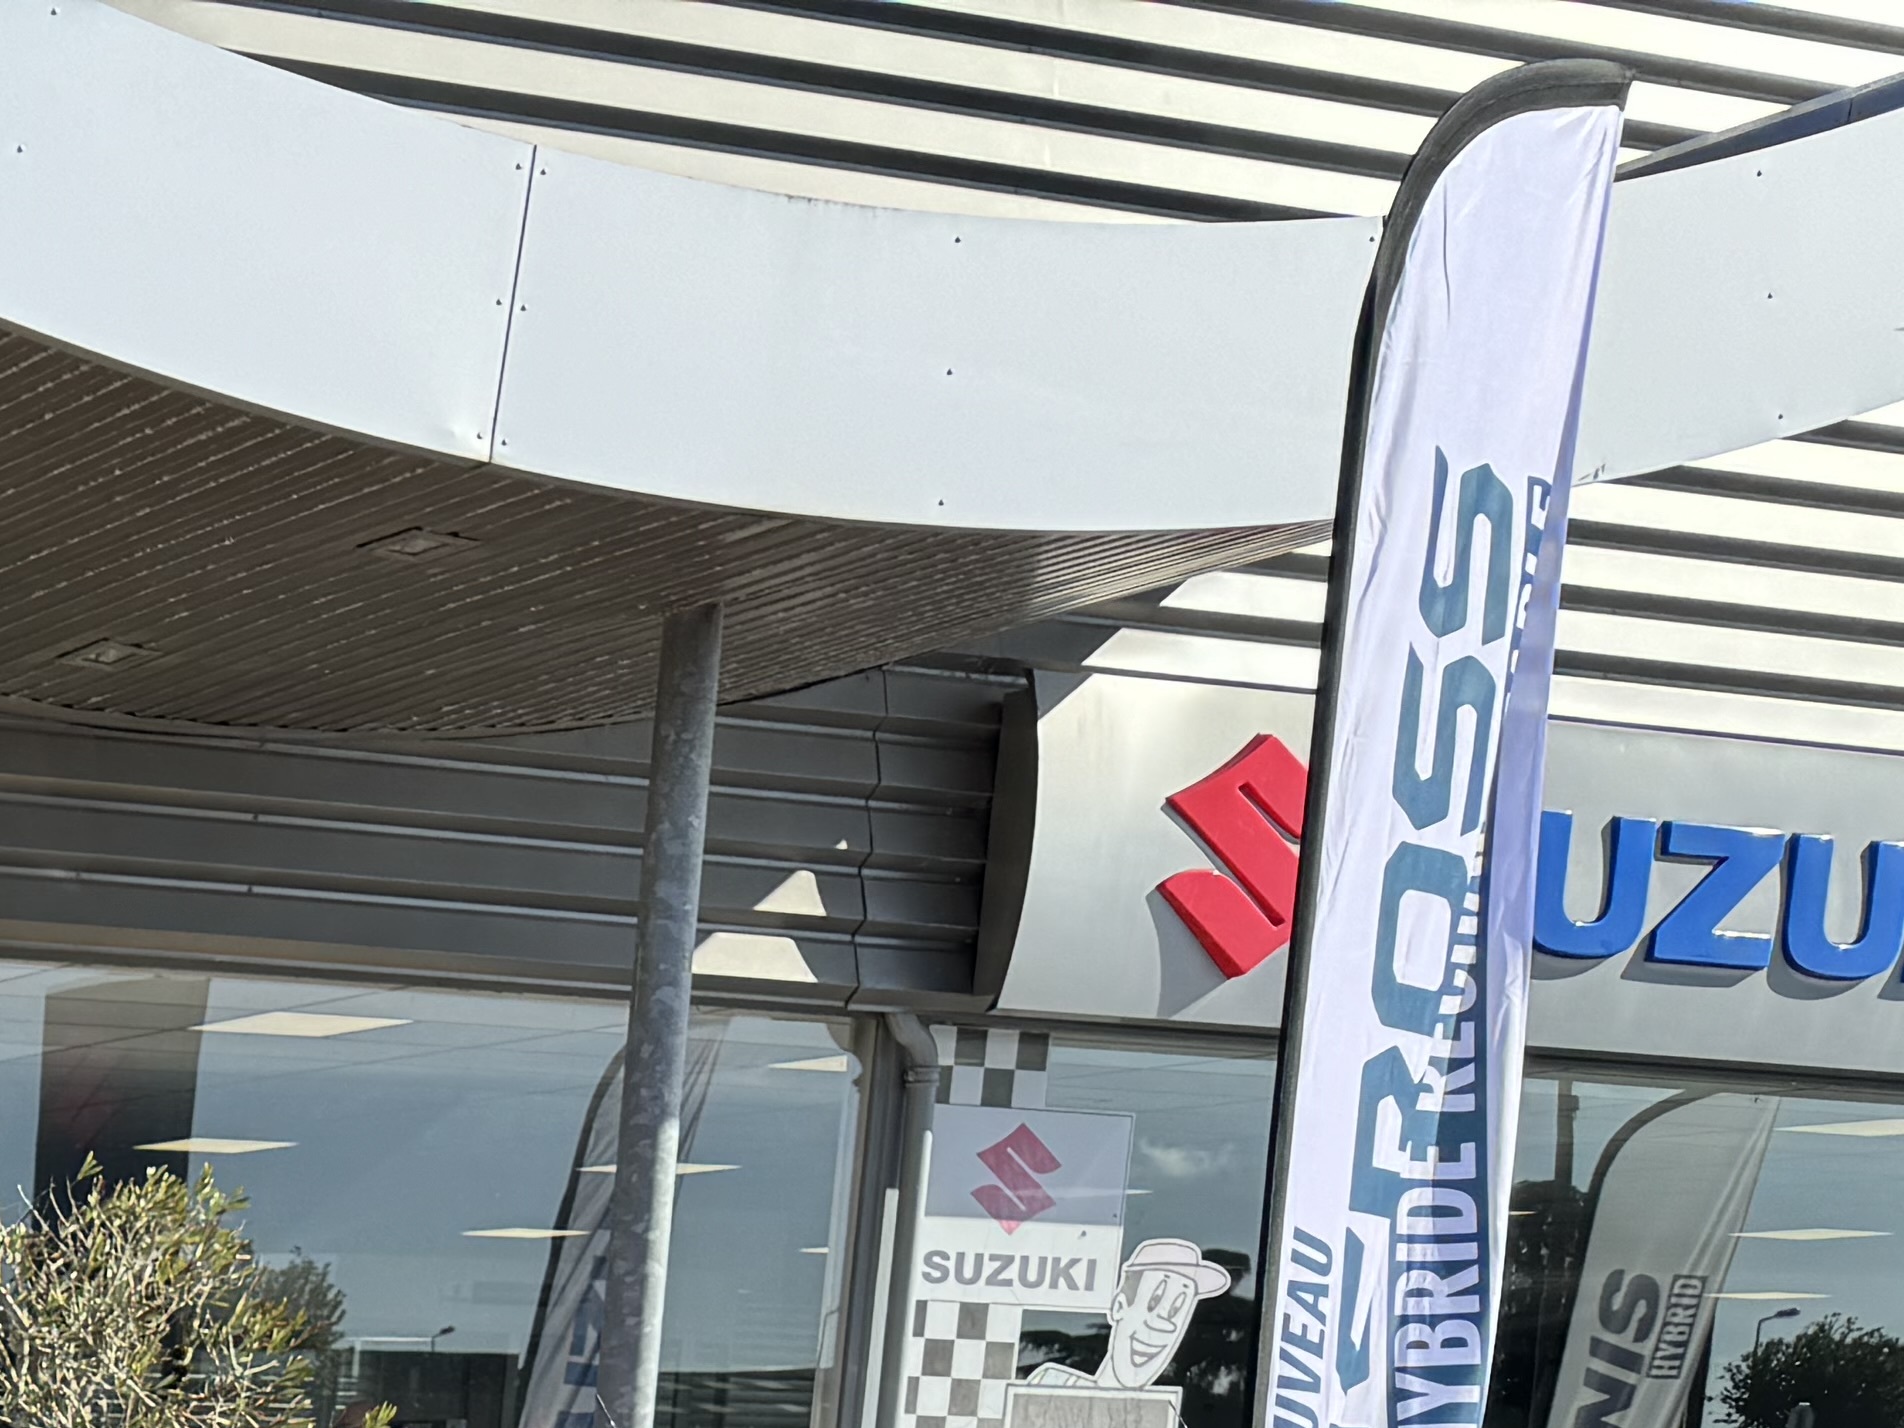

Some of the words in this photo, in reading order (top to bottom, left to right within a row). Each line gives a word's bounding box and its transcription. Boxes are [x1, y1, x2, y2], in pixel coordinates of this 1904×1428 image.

[1533, 810, 1904, 981] UZU
[921, 1250, 1097, 1292] SUZUKI
[1652, 1276, 1702, 1377] HYBRID
